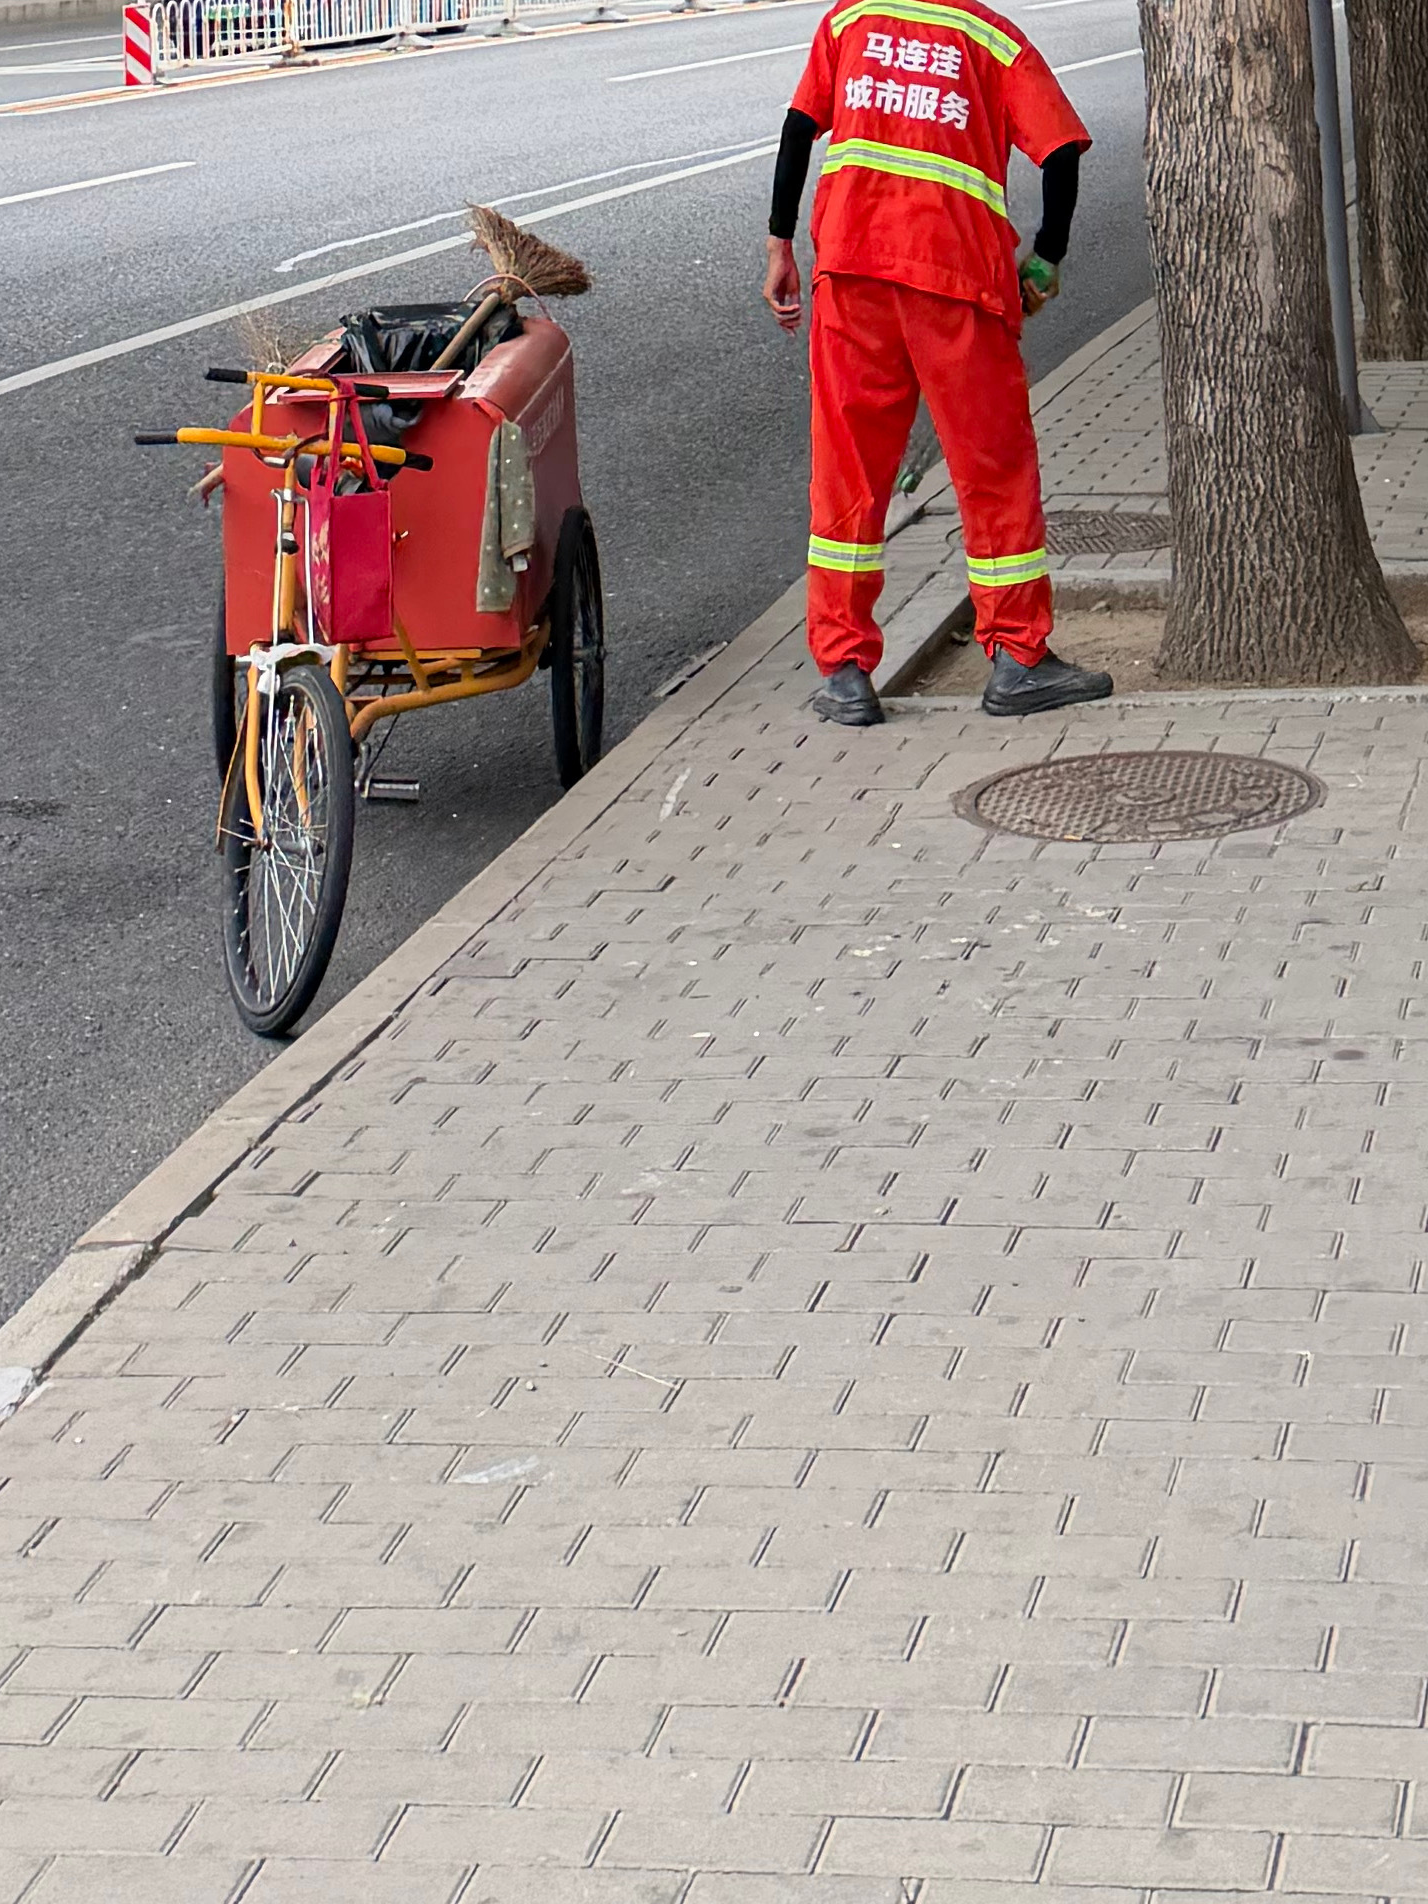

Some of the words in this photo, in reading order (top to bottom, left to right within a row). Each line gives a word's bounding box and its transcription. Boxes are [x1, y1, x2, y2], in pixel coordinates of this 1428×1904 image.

[862, 32, 962, 80] 马连洼
[845, 74, 970, 130] 城市服务
